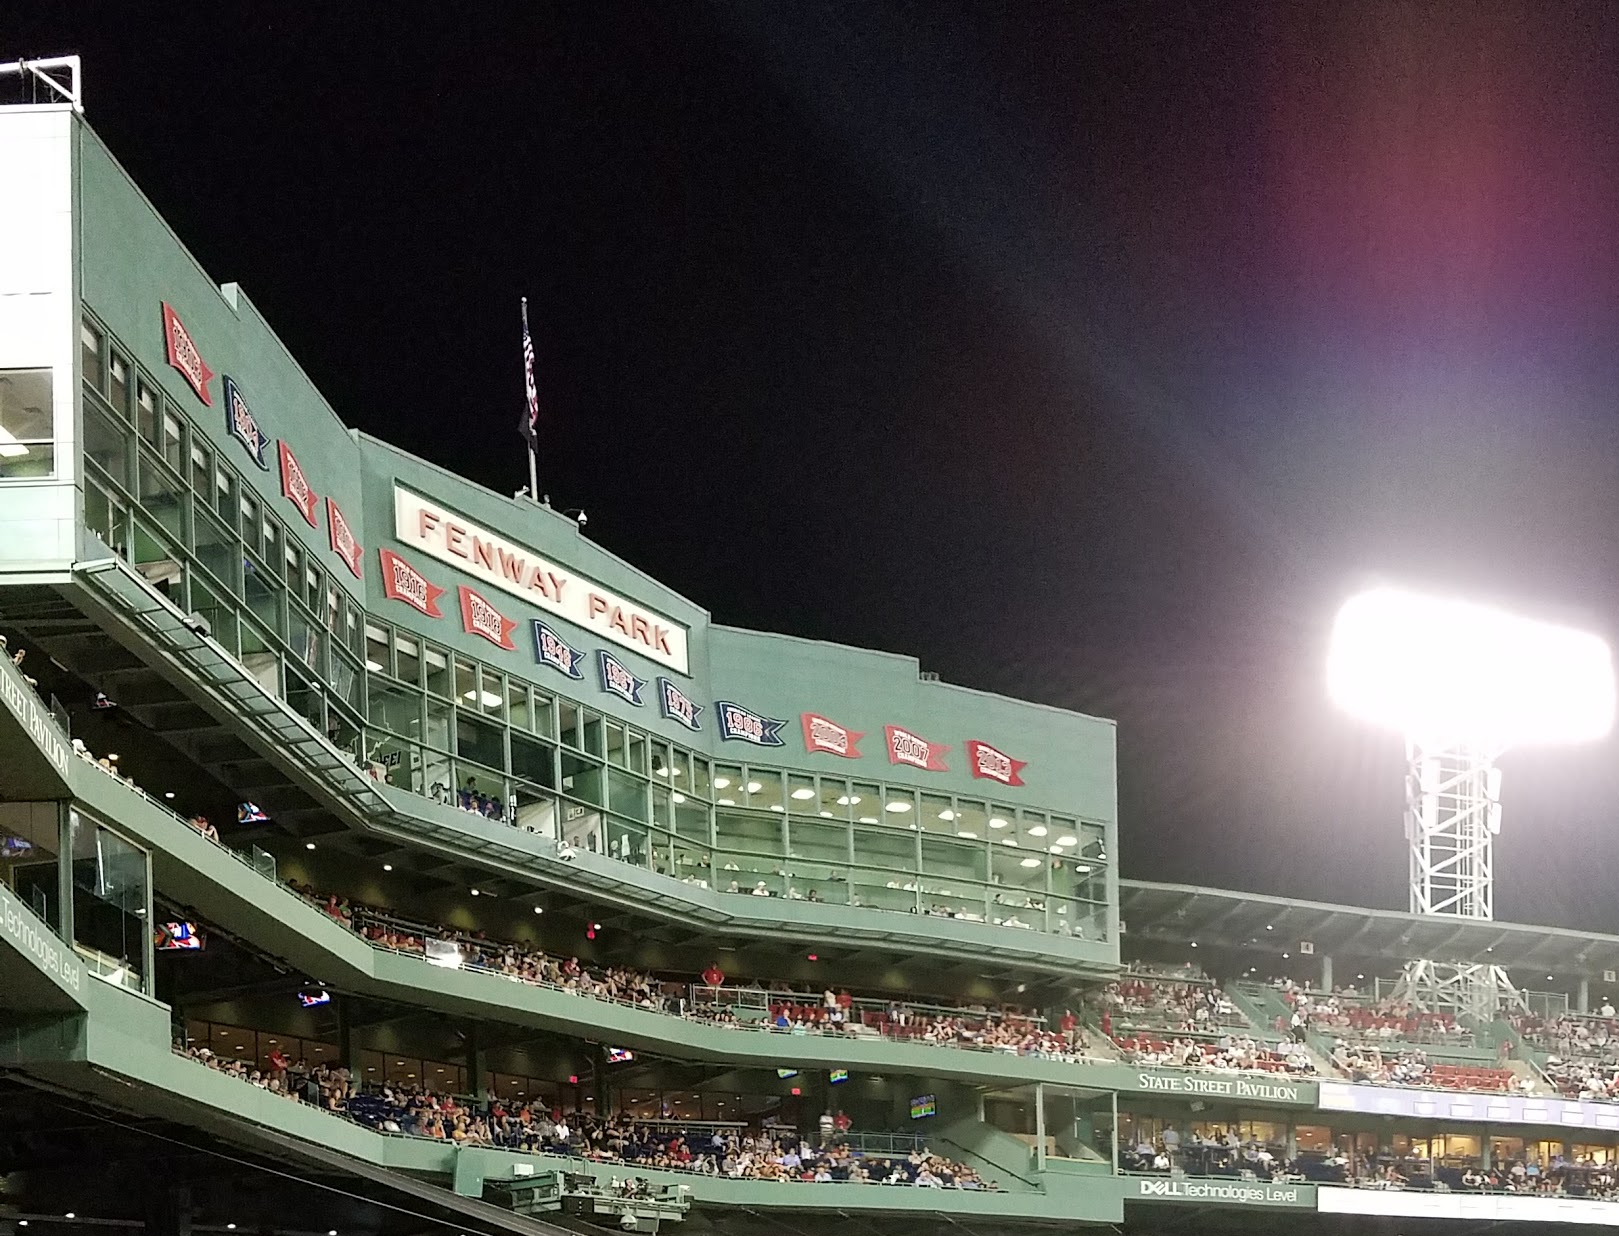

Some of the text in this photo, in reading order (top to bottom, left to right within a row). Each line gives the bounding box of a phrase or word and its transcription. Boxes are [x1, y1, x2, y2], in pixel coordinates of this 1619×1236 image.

[393, 566, 427, 602] 1916
[419, 509, 567, 603] FENWAY
[589, 593, 672, 656] PARK
[29, 704, 70, 777] PAVILION
[892, 735, 929, 761] 2007
[1139, 1073, 1298, 1101] STATE STREET PAVILION
[1140, 1180, 1297, 1201] DELL Technologies Level
